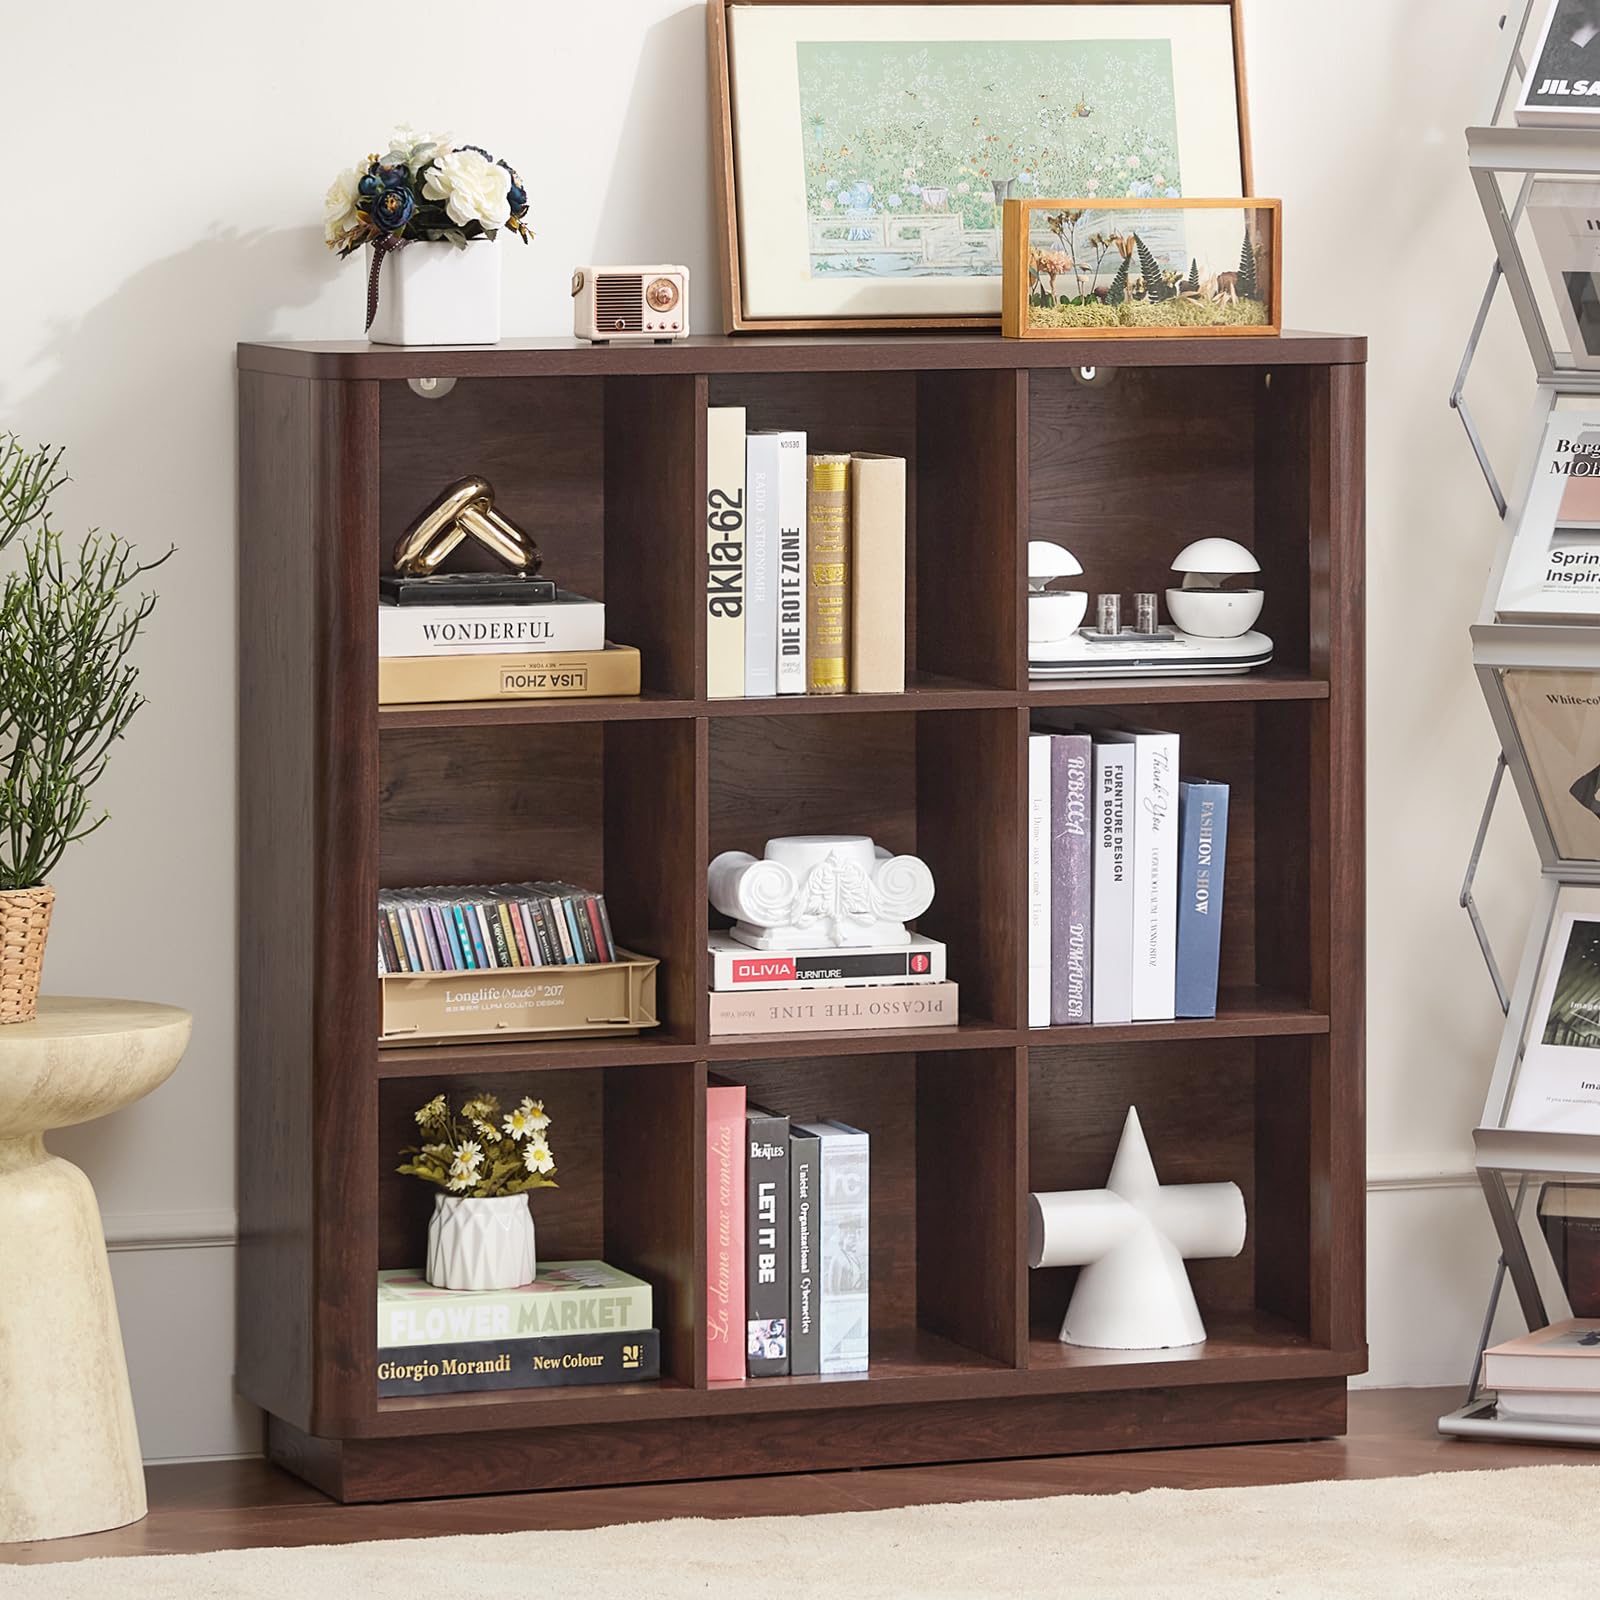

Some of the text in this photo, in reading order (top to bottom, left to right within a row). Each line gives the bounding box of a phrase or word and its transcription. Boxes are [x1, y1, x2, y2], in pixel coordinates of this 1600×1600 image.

[708, 487, 743, 618] akla-62
[781, 527, 800, 574] ZONE
[782, 577, 800, 623] ROTE
[423, 621, 554, 641] WONDERFUL
[782, 627, 800, 656] DIE
[505, 674, 583, 688] LISA ZHOU
[1151, 747, 1170, 795] Thank
[1067, 756, 1085, 836] REBECCA
[1103, 765, 1112, 848] IDEA BOOK08
[1144, 795, 1167, 832] You
[1113, 765, 1123, 882] FURNITURE DESIGN
[1195, 801, 1214, 915] FASHION SHOW
[738, 963, 841, 980] OLIVIA FURNITURE
[445, 989, 500, 1005] Longlife
[544, 984, 565, 997] 207
[769, 1005, 815, 1019] LINE
[825, 1004, 863, 1017] THE
[869, 1000, 943, 1015] PICASSO
[718, 1210, 730, 1247] aux
[758, 1182, 776, 1284] LET IT BE
[710, 1251, 729, 1304] dame
[390, 1296, 632, 1342] FLOWER MARKET
[707, 1309, 729, 1344] La
[377, 1354, 511, 1381] Giorgio Morandi
[533, 1353, 604, 1370] New Colour
